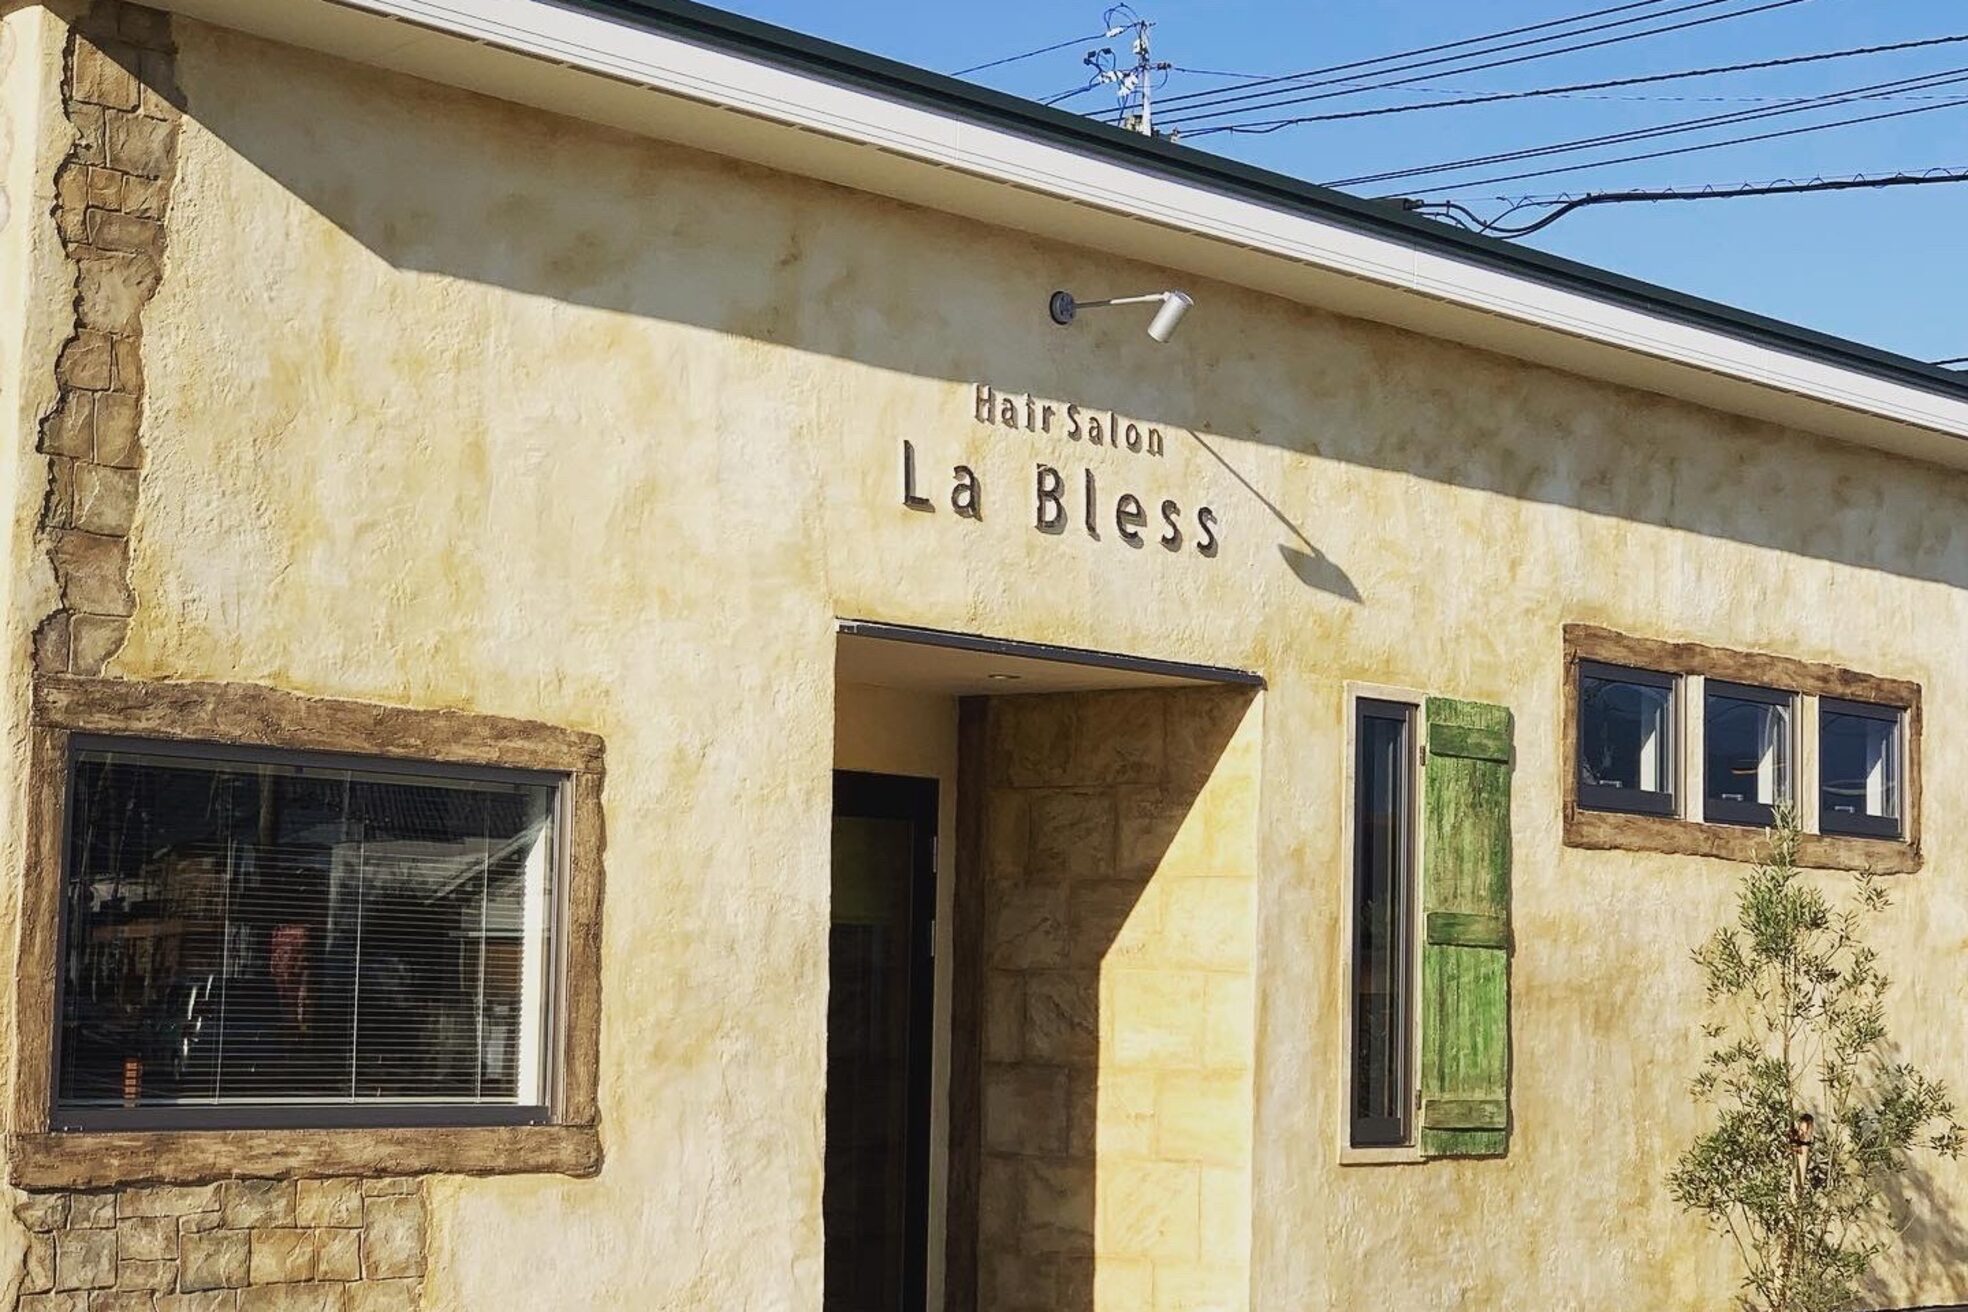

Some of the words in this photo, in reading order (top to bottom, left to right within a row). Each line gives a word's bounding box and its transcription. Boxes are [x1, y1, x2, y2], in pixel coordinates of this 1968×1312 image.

[974, 384, 1055, 434] Hair
[1067, 402, 1164, 457] Salon
[903, 439, 983, 521] La
[1035, 463, 1218, 557] Bless
